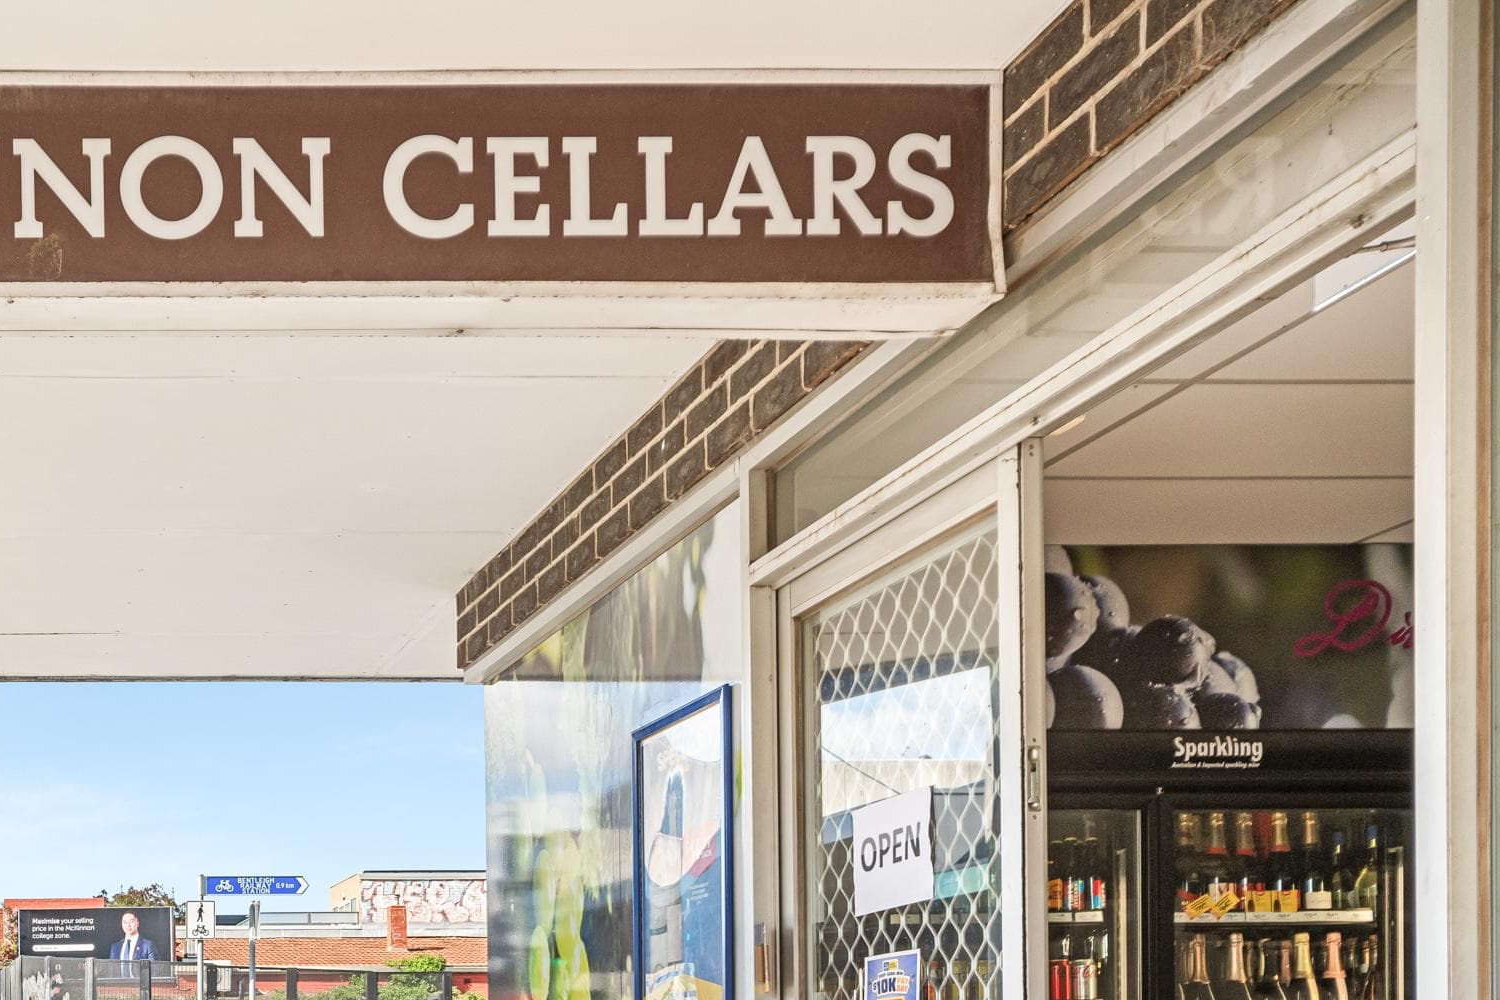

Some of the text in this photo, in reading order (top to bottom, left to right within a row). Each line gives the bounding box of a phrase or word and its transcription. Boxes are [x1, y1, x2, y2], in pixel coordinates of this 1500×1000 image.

[382, 133, 955, 240] CELLARS
[1174, 736, 1263, 762] Sparkling
[861, 821, 921, 872] OPEN
[75, 917, 94, 925] selling
